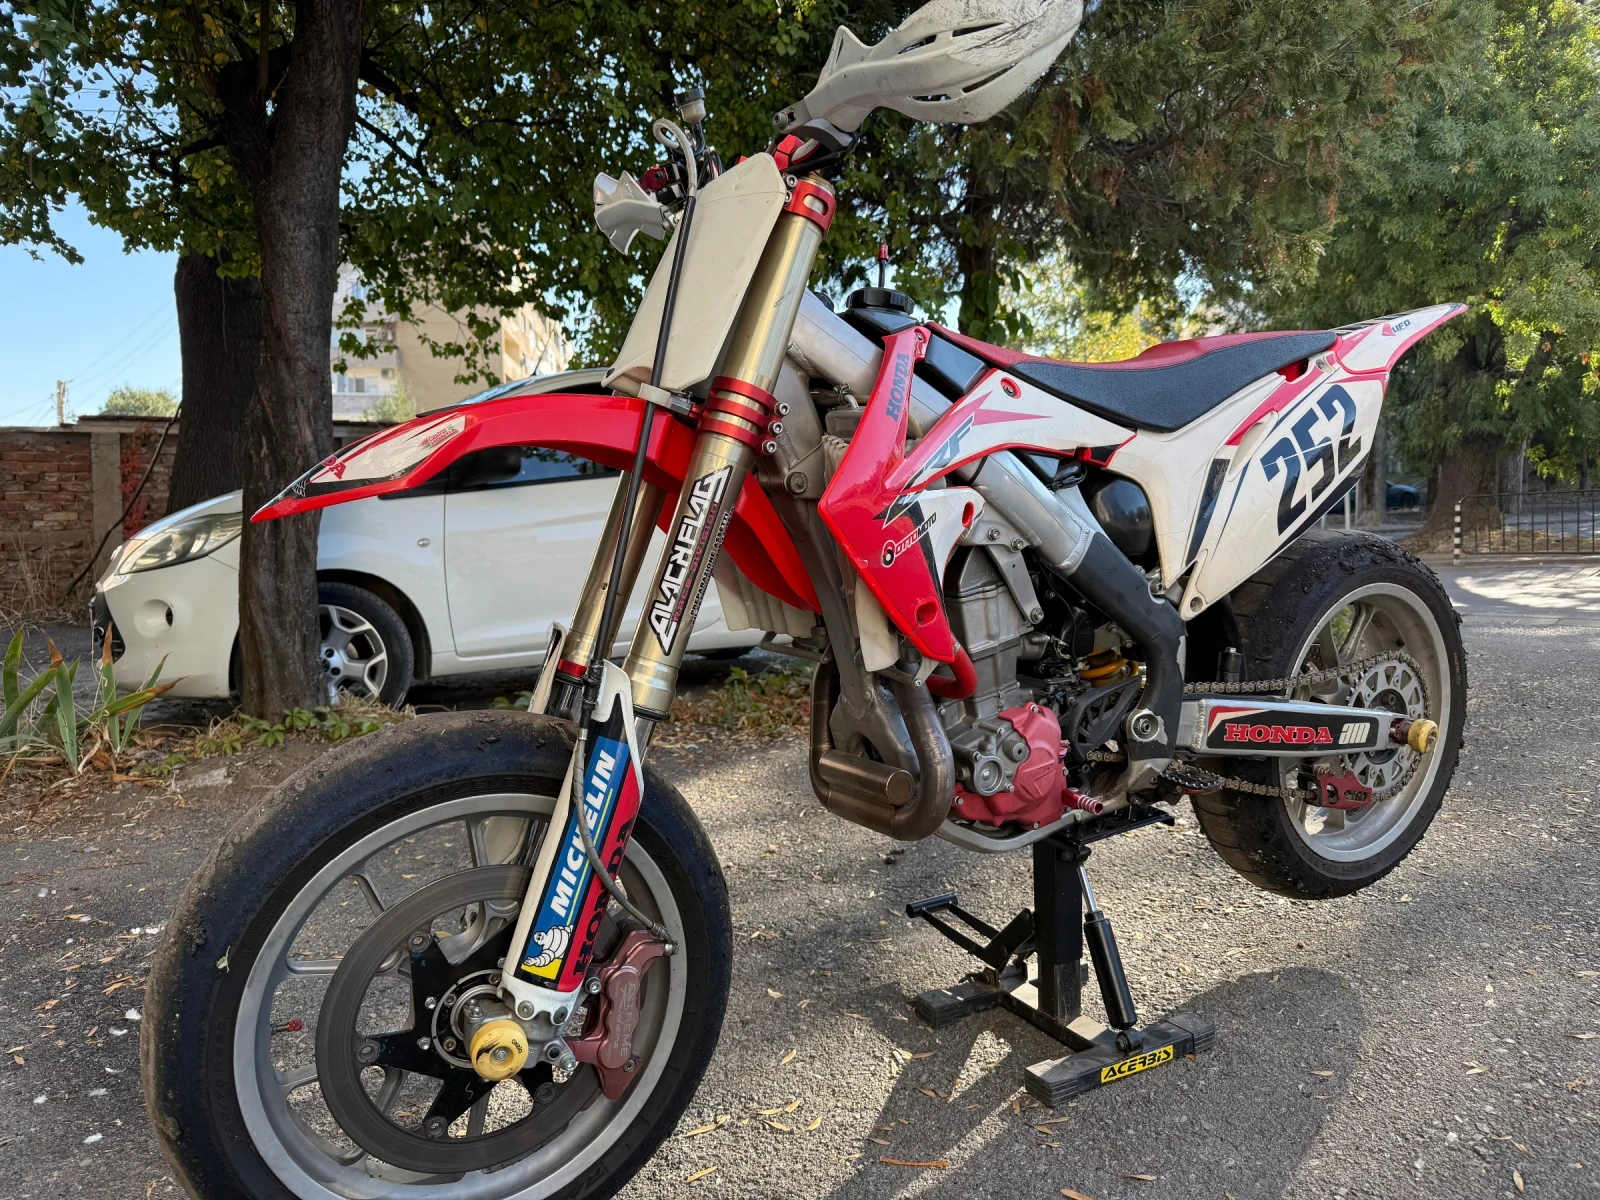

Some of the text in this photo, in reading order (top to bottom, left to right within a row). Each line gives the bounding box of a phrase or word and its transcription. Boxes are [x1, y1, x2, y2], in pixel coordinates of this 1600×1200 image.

[1391, 319, 1411, 333] UFO
[885, 353, 910, 423] HONDA
[1260, 384, 1361, 536] 252
[690, 550, 716, 617] PREPARAZIONE
[713, 511, 729, 548] ASSETTI
[1223, 723, 1333, 744] HONDA
